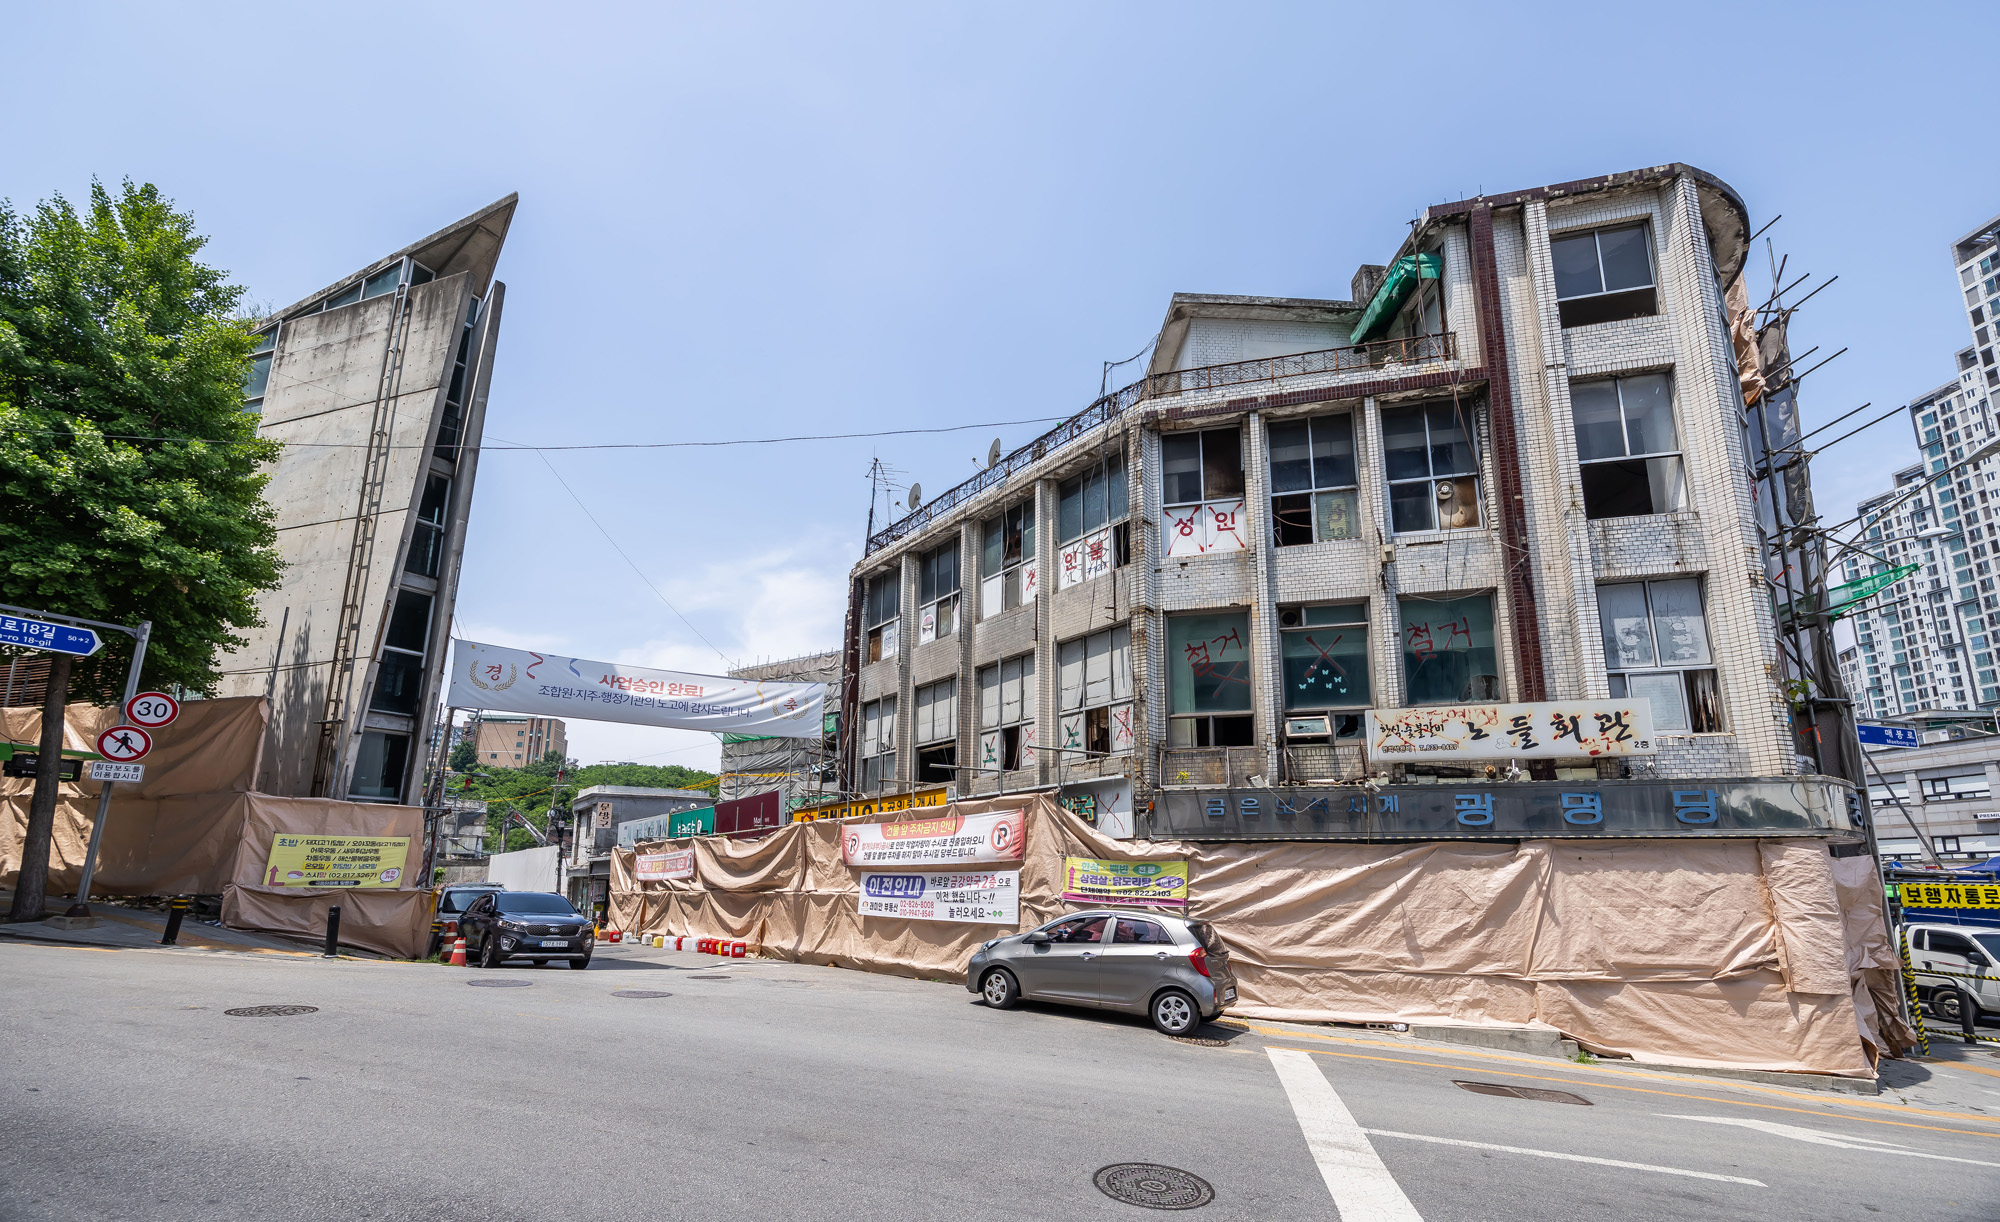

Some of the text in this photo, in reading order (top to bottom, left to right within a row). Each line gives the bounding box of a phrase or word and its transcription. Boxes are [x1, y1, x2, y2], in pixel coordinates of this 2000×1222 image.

[0, 617, 56, 639] 로18길
[23, 636, 51, 647] 18-gil
[1406, 617, 1473, 662] 철거
[1184, 627, 1243, 677] 철거
[484, 663, 503, 682] 경
[598, 674, 704, 698] 사업승인 완료!
[137, 701, 168, 718] 30
[657, 699, 689, 713] 노고에
[691, 702, 752, 718] 감사드립니다.
[783, 697, 798, 712] 축
[1466, 710, 1633, 750] 노들회관
[1634, 741, 1650, 749] 2층
[94, 771, 139, 780] 이용합시다
[95, 763, 140, 773] 횡단보도를
[886, 819, 956, 837] 건물 앞 주차금지 안내
[278, 838, 298, 847] 초밥
[895, 841, 905, 850] 인한
[906, 839, 930, 850] 작업차량이
[931, 838, 949, 847] 수시로
[949, 835, 985, 847] 진출입하오니
[887, 850, 901, 860] 주차를
[940, 847, 976, 858] 당부드립니다
[1081, 862, 1100, 873] 한식
[1109, 864, 1130, 875] 백반
[869, 877, 922, 896] 이전안내
[931, 876, 950, 887] 바로앞
[936, 891, 949, 903] 이전
[1906, 887, 2000, 905] 보행자통로
[884, 902, 899, 912] 부동산
